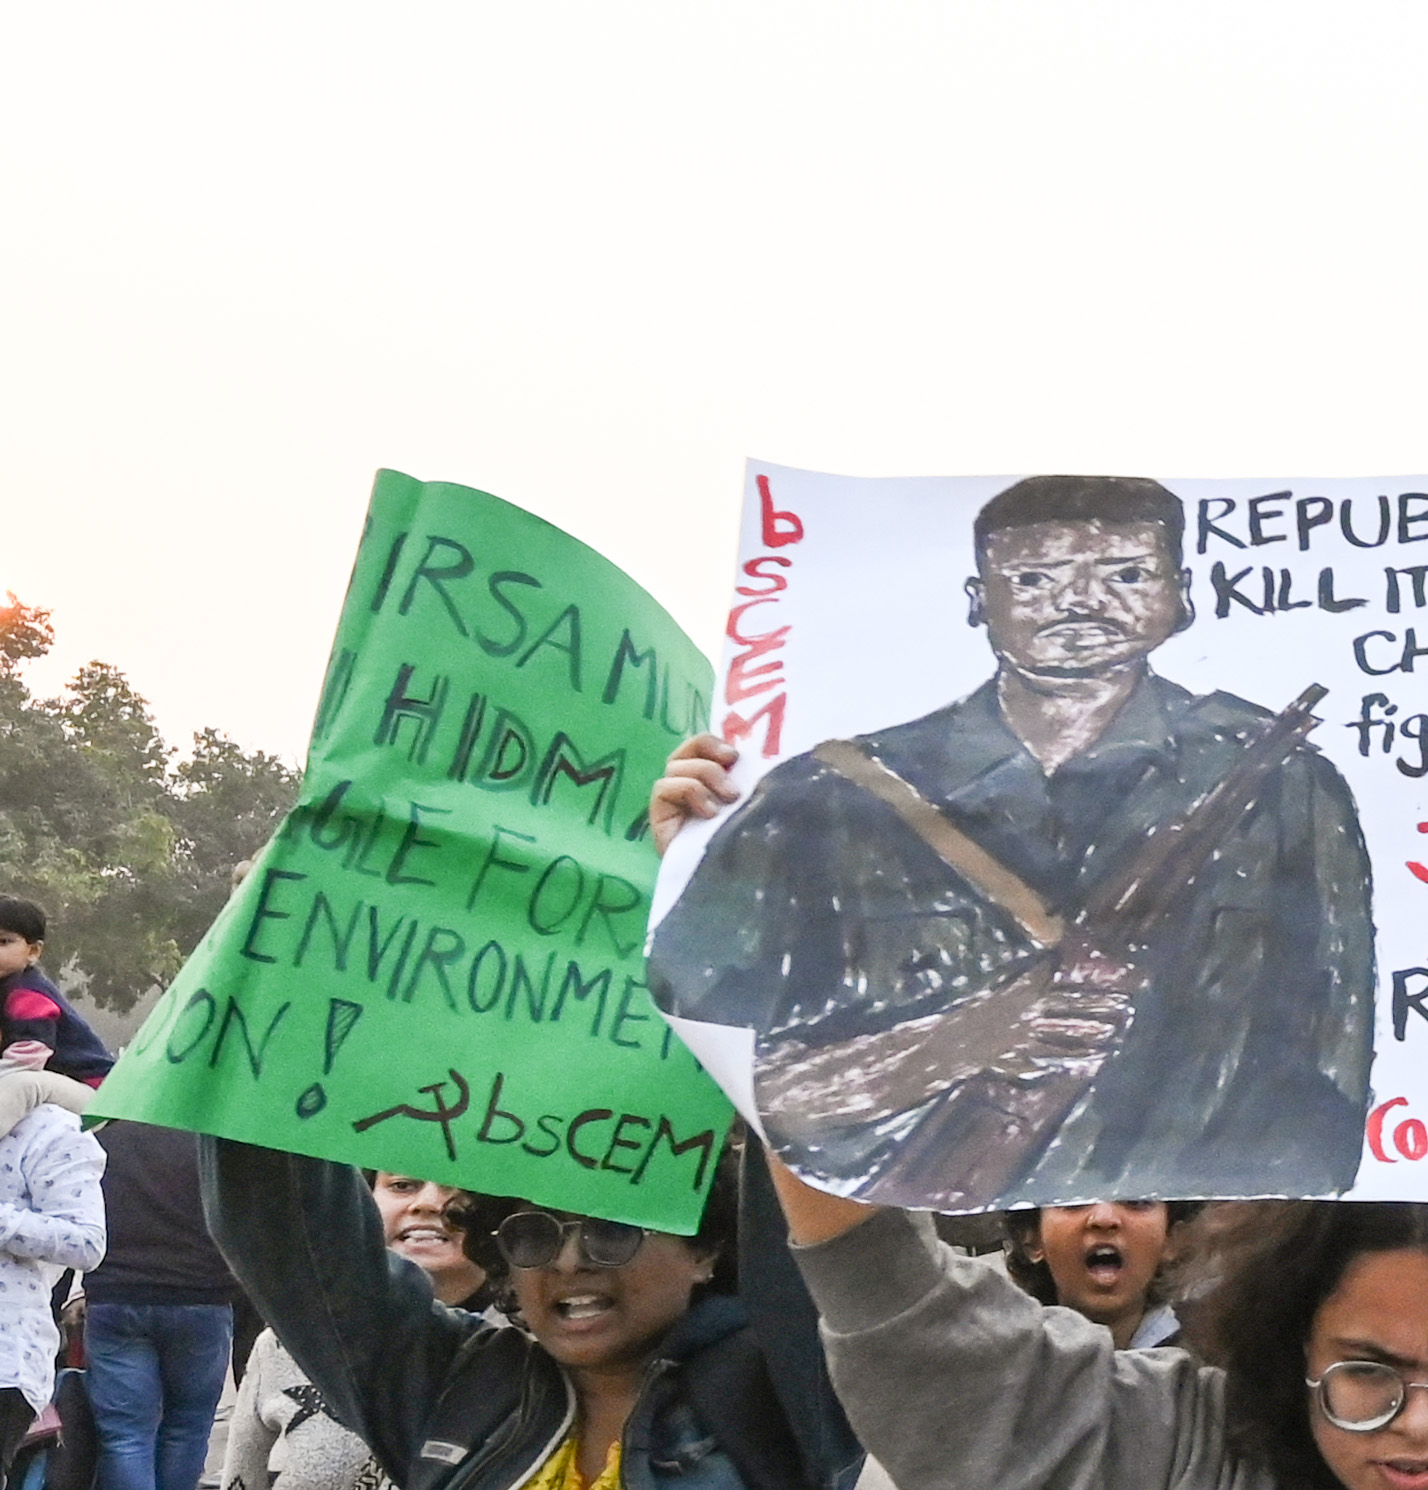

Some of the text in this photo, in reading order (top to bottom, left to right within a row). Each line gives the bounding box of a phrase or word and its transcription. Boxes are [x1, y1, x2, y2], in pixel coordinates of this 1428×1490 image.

[368, 528, 582, 693] IRSA
[1211, 561, 1371, 620] KILL
[373, 662, 651, 842] HIDM
[466, 824, 640, 961] FOR
[477, 1072, 715, 1190] bsCEM
